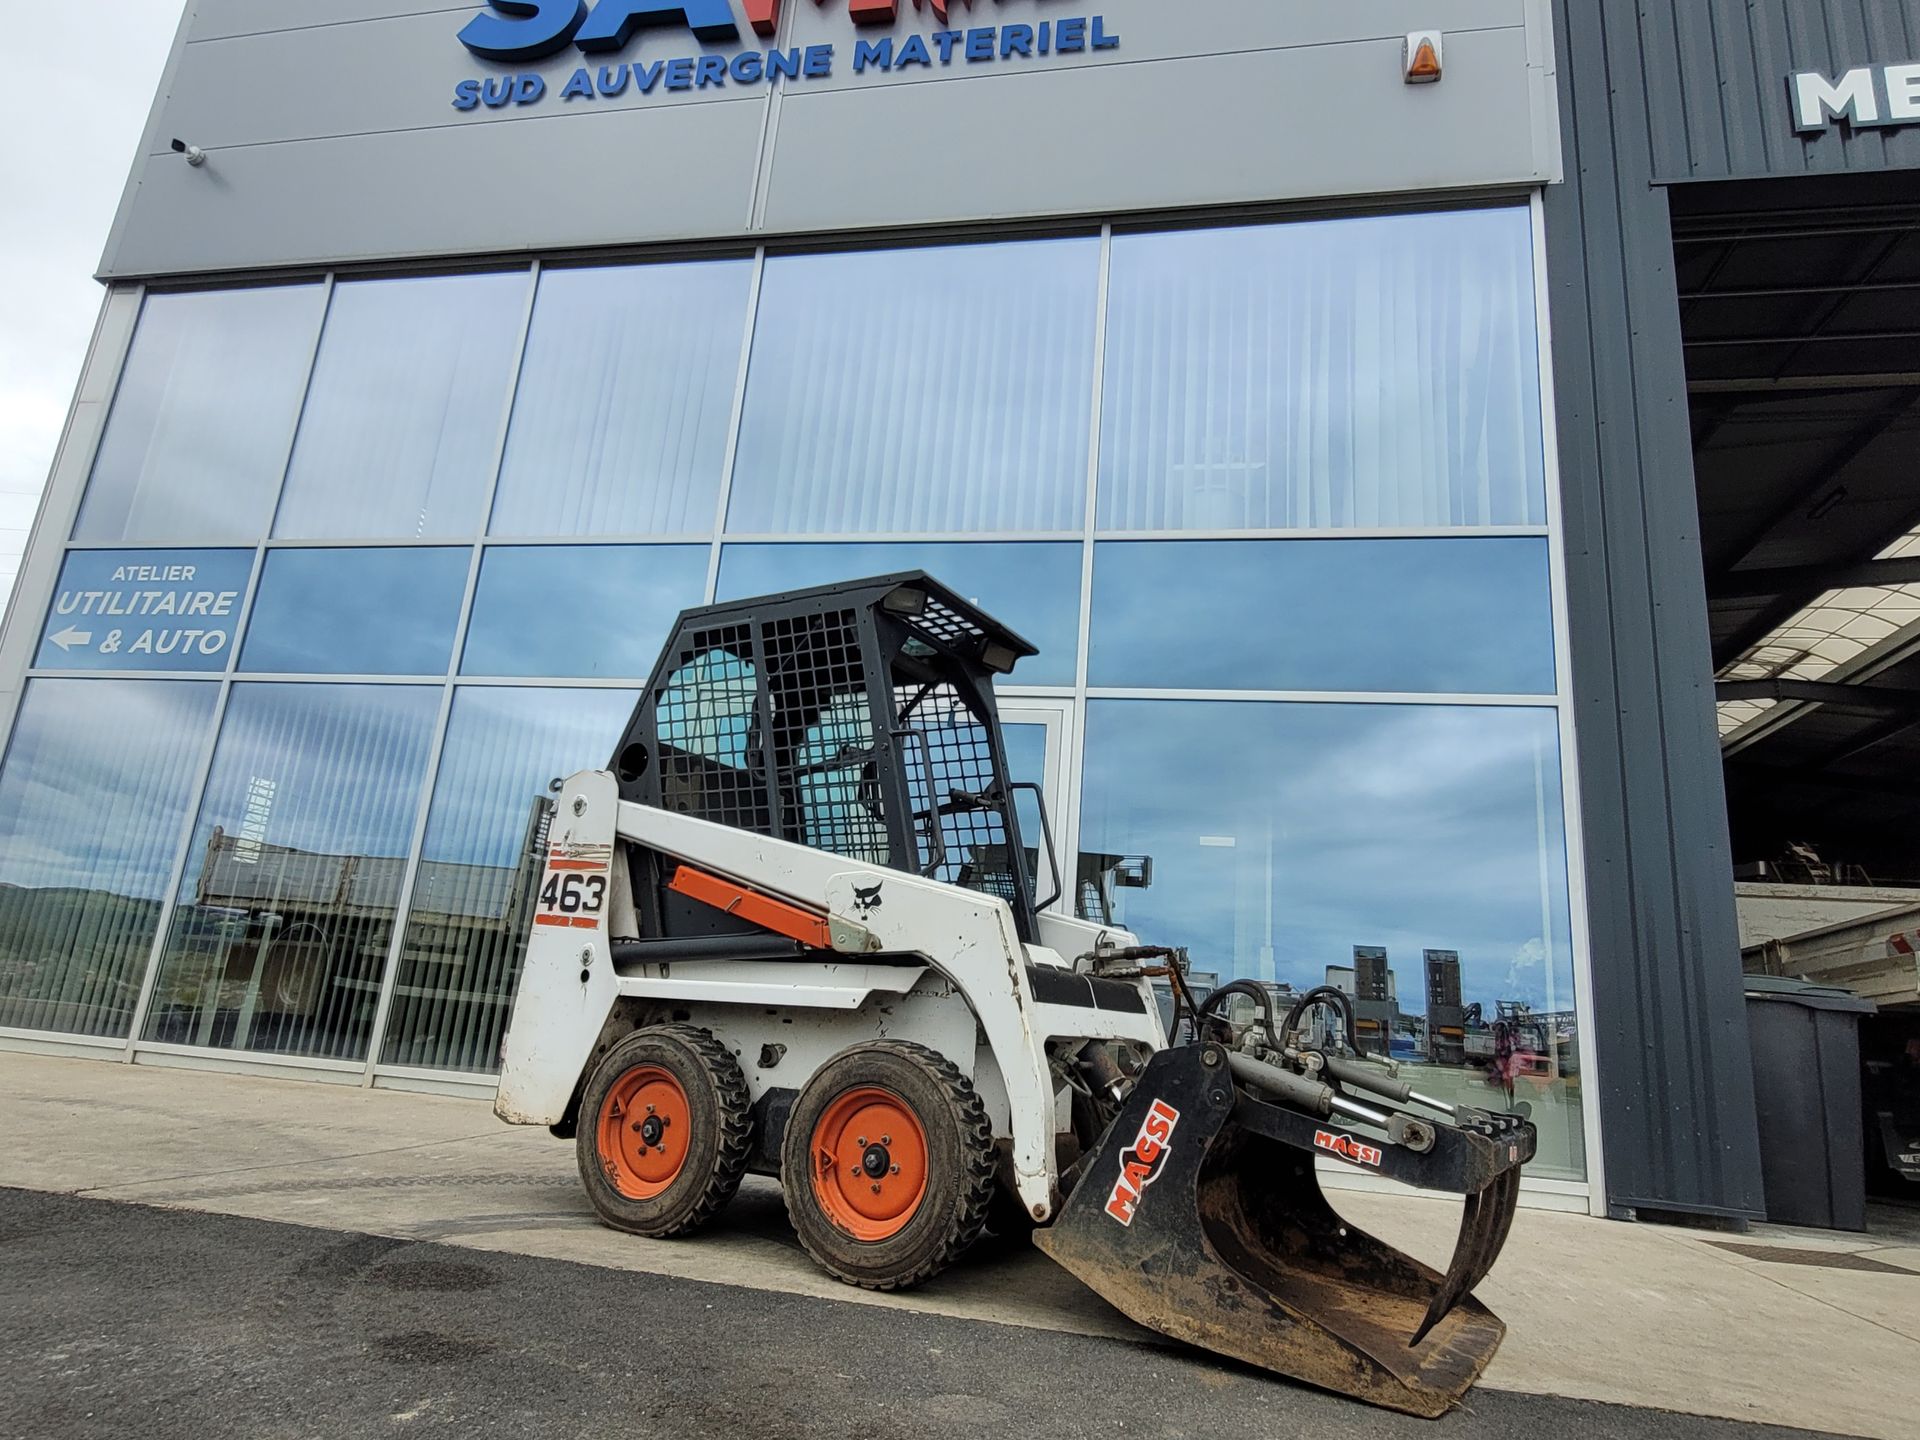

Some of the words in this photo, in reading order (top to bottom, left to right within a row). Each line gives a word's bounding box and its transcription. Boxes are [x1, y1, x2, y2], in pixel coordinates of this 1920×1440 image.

[452, 73, 546, 111] SUD
[559, 43, 834, 99] AUVERGNE
[852, 15, 1120, 71] MATERIEL
[111, 566, 196, 581] ATELIER
[56, 591, 238, 615] UTILITAIRE
[99, 629, 122, 654] &
[128, 629, 227, 655] AUTO
[540, 873, 606, 912] 463
[1106, 1101, 1177, 1223] MAGSI
[1315, 1131, 1380, 1165] MAGSI
